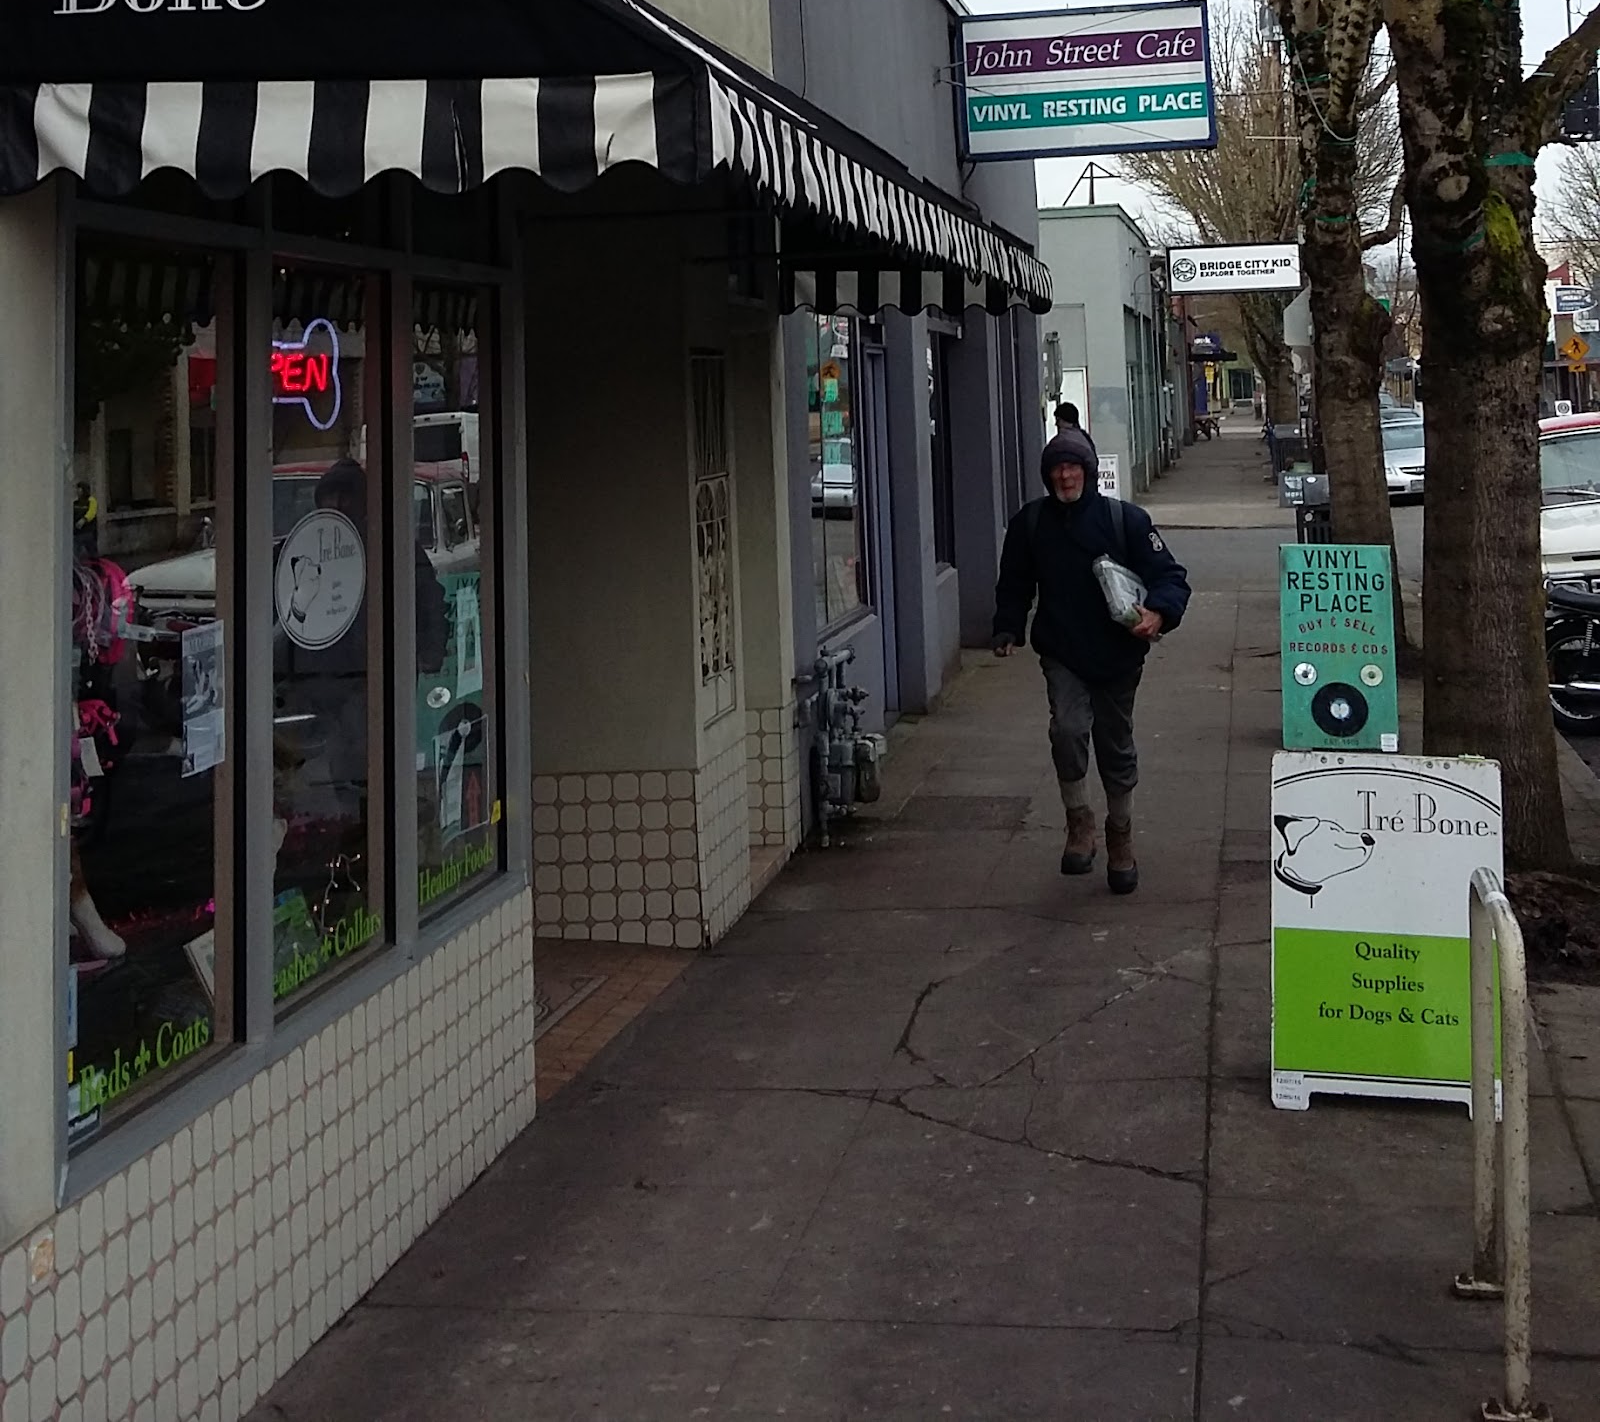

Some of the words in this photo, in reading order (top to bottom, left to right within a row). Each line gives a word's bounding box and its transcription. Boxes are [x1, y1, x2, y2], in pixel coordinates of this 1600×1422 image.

[971, 42, 1032, 75] John
[1045, 36, 1122, 67] Street
[1136, 29, 1197, 60] Cafe
[973, 101, 1031, 124] VINYL
[1043, 95, 1127, 119] RESTING
[1138, 90, 1204, 113] PLACE
[1199, 260, 1242, 271] BRIDGE
[1244, 259, 1269, 268] CITY
[1271, 258, 1291, 267] KID
[1237, 268, 1275, 276] TOGETHER
[271, 352, 328, 392] PEN
[1303, 549, 1367, 569] VINYL
[1287, 571, 1386, 591] RESTING
[1300, 593, 1373, 613] PLACE
[1298, 618, 1322, 634] BUY
[1343, 617, 1377, 636] SELL
[1289, 642, 1346, 654] RECORDS
[1357, 790, 1404, 832] Tré
[419, 852, 463, 906] Healthy
[464, 831, 495, 877] Foods
[272, 944, 318, 998] eashes
[334, 907, 382, 958] Collars
[1355, 941, 1421, 963] Quality
[1351, 972, 1424, 993] Supplies
[1318, 1001, 1344, 1019] for
[1349, 1004, 1392, 1025] Dogs
[1398, 1007, 1415, 1024] &
[1421, 1008, 1459, 1026] Cats
[80, 1047, 130, 1115] Beds
[156, 1014, 209, 1069] Coats
